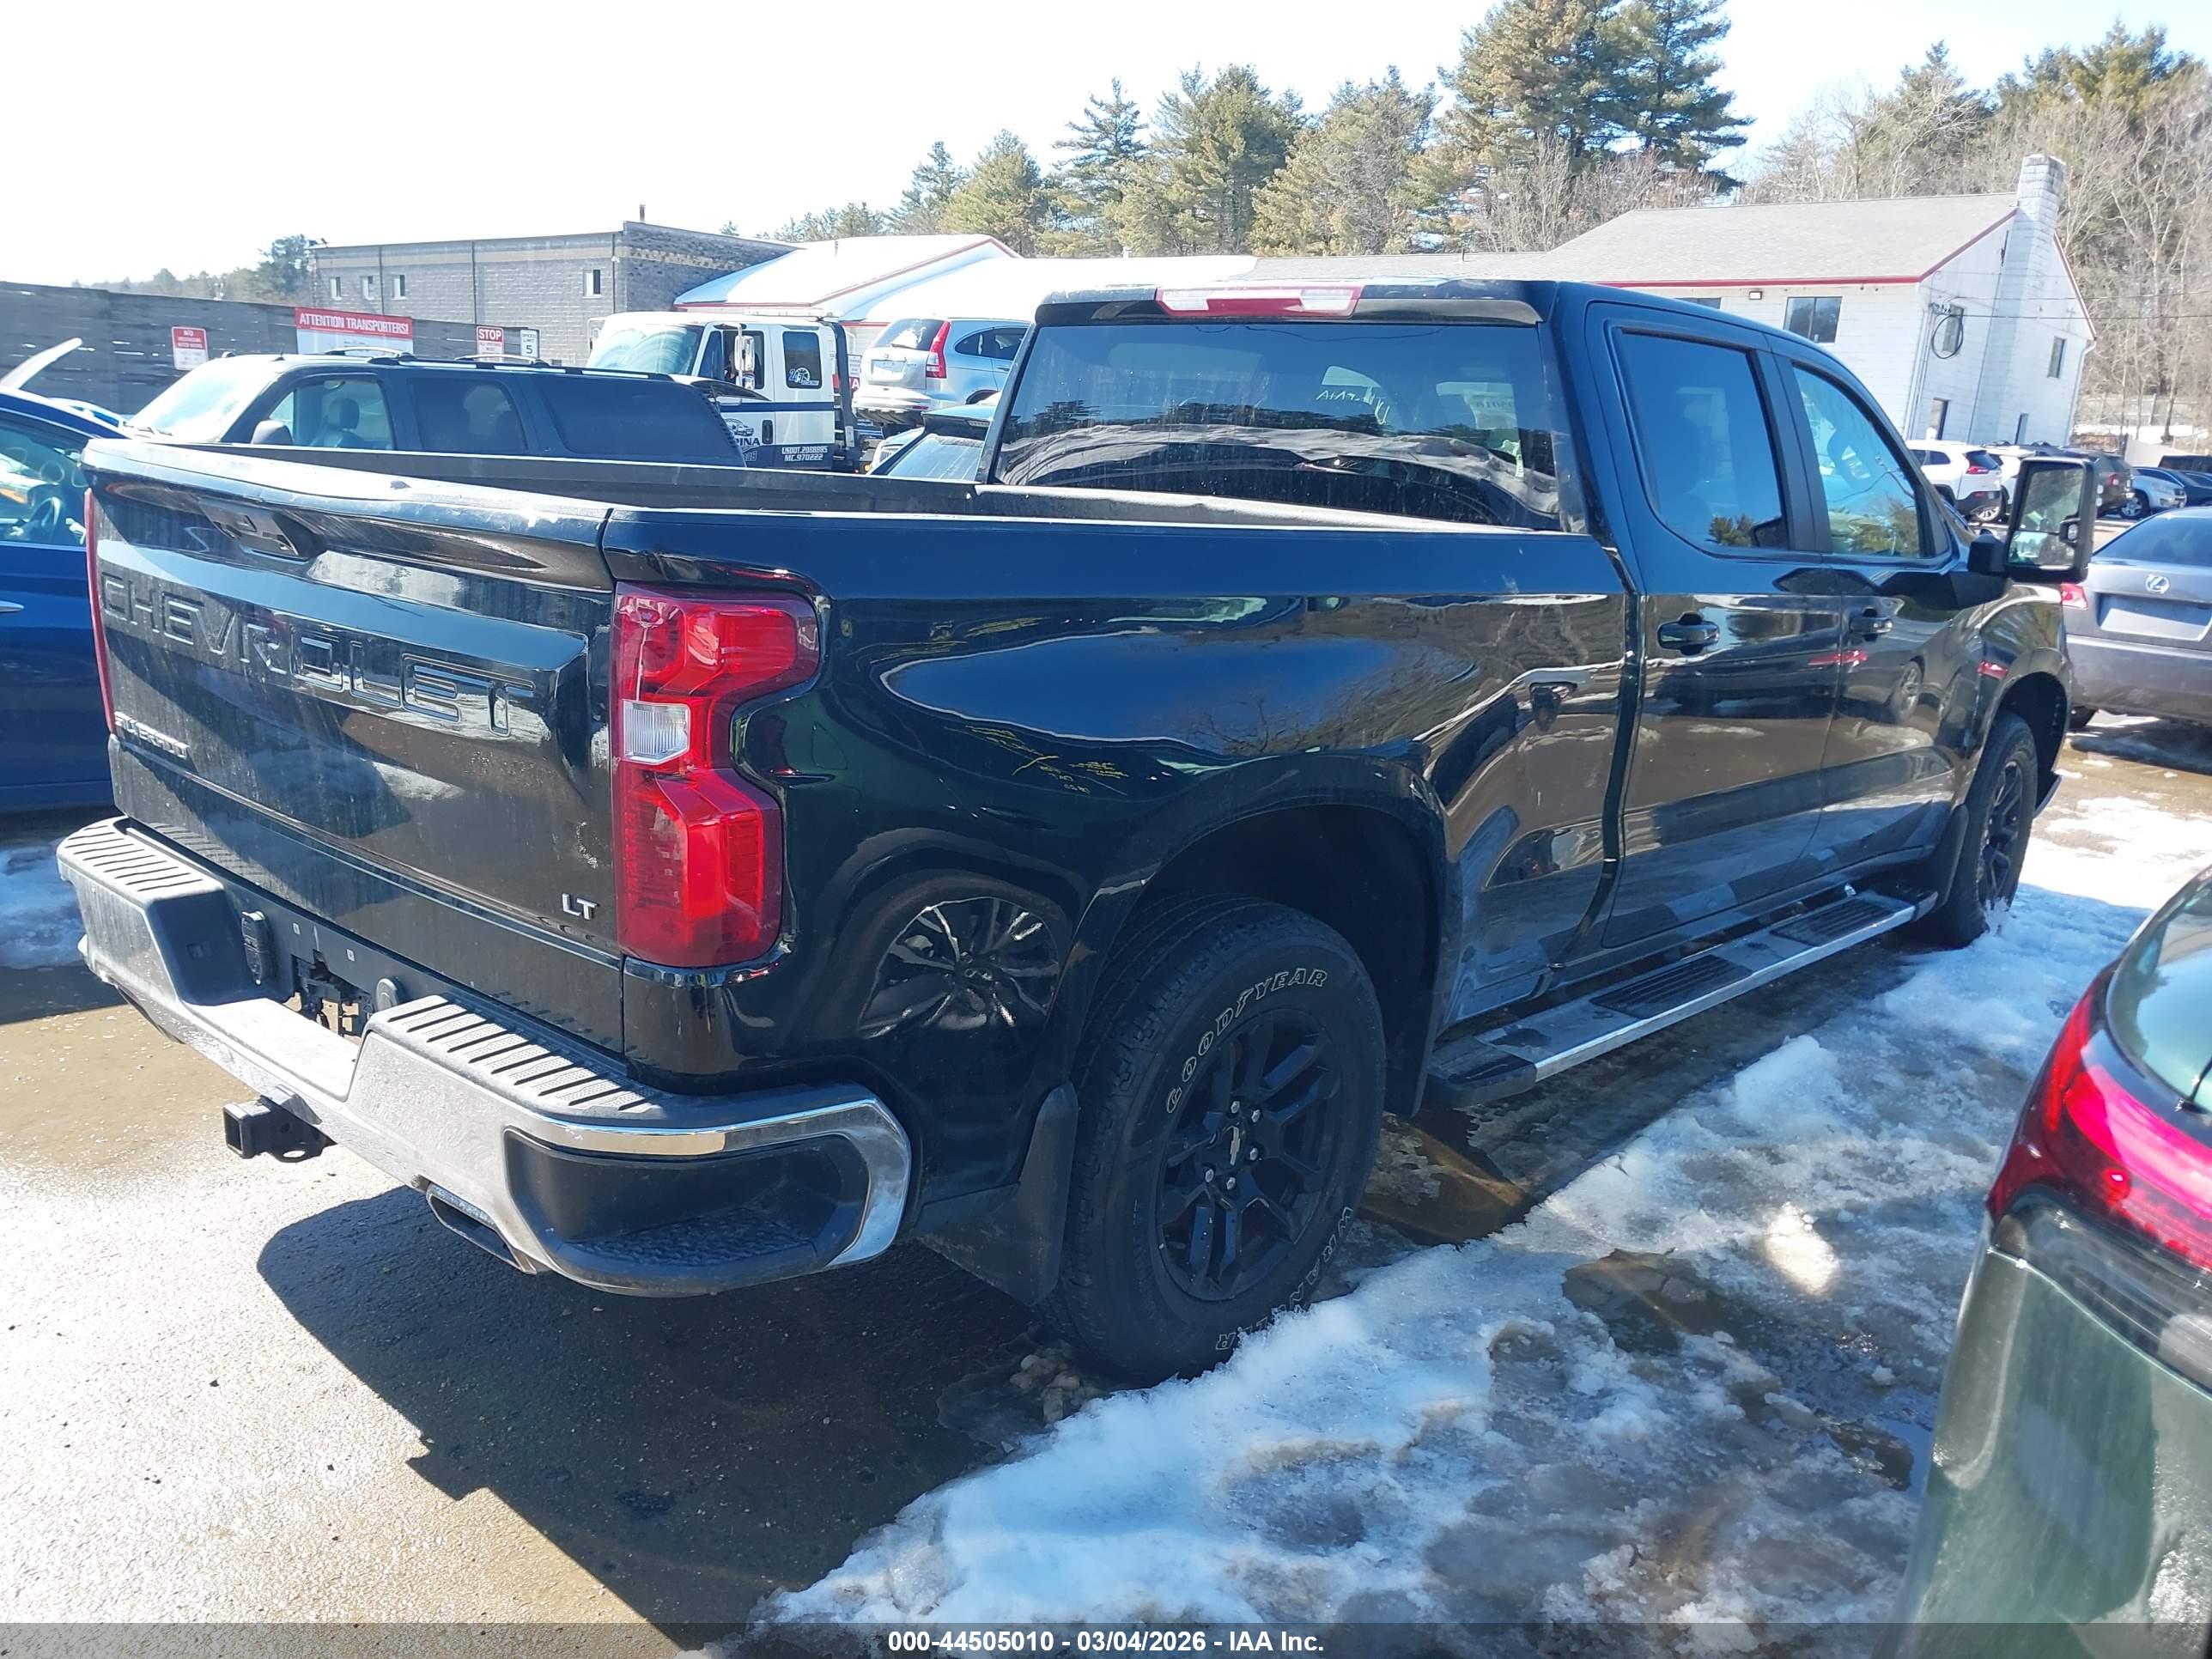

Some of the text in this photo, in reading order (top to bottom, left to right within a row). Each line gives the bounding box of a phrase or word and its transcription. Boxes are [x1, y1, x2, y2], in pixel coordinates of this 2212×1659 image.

[299, 313, 410, 335] ATTENTION TRANSPORTERS!
[478, 329, 501, 340] STOP
[526, 344, 533, 354] 5
[100, 570, 537, 738] CHEVROLET
[562, 892, 598, 921] LT
[1165, 966, 1328, 1114] GOODYEAR
